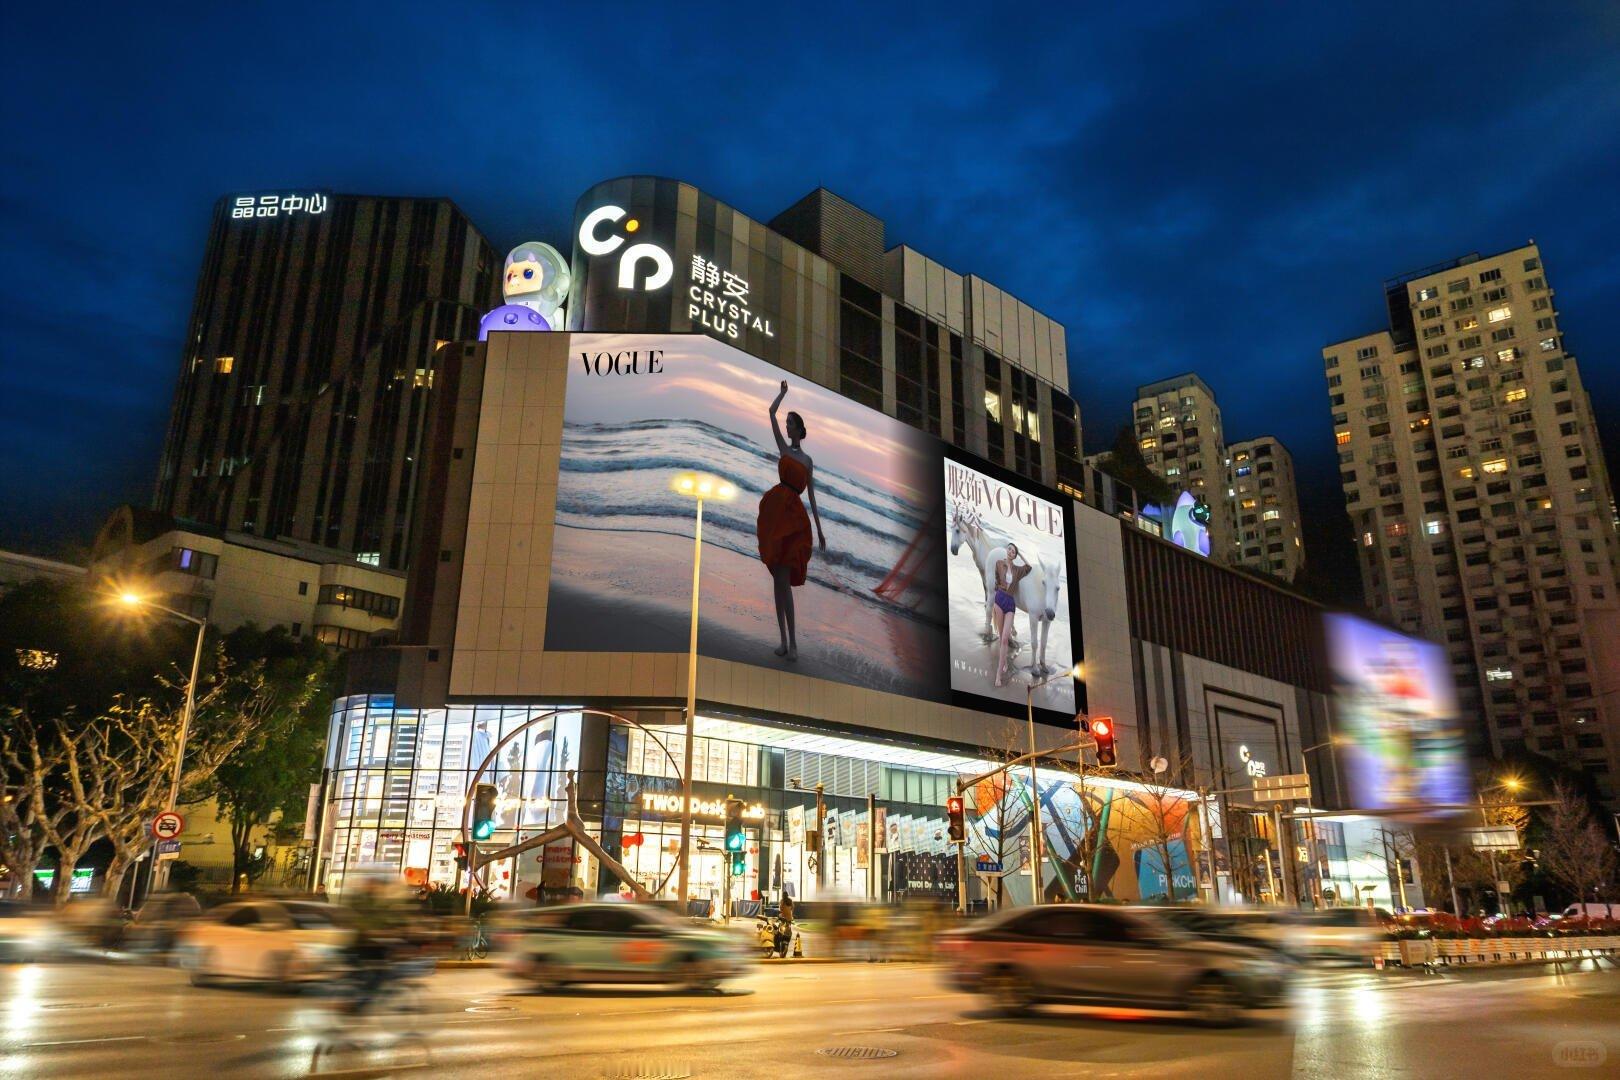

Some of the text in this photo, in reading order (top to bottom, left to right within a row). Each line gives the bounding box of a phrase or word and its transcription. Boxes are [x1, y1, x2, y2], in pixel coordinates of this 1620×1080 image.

[232, 193, 327, 218] 晶品中心
[691, 254, 749, 305] 静安
[689, 286, 774, 337] CRYSTAL
[689, 304, 738, 338] PLUS
[580, 350, 664, 377] VOGUE
[980, 478, 1063, 537] VOGUE
